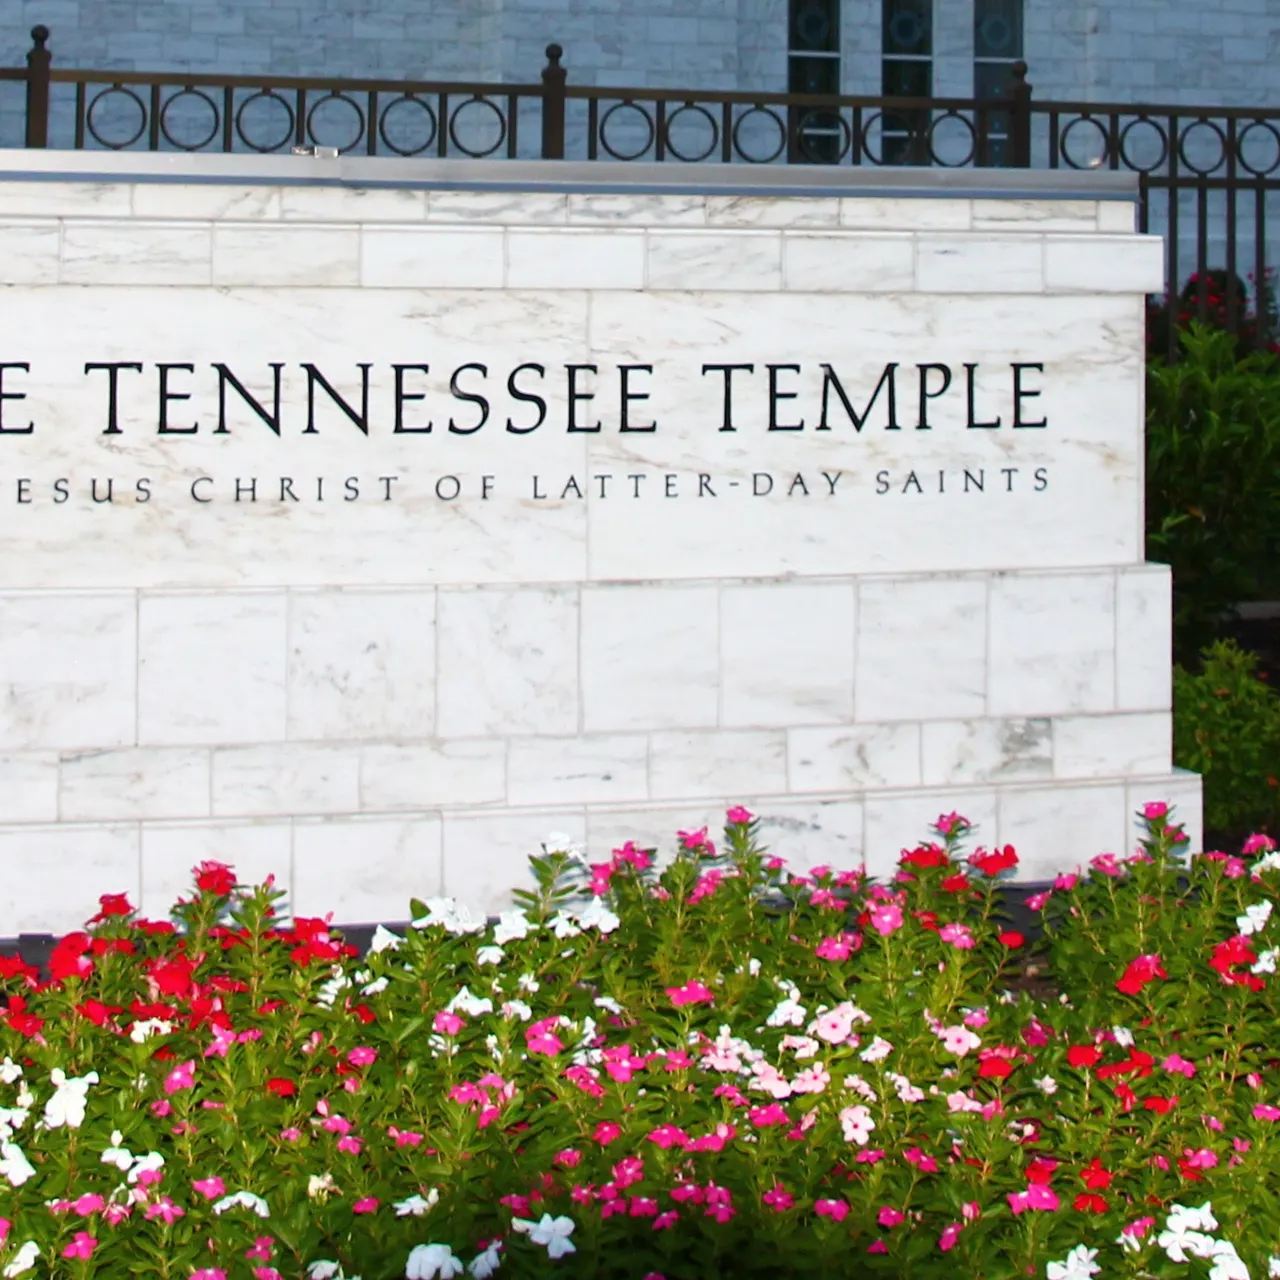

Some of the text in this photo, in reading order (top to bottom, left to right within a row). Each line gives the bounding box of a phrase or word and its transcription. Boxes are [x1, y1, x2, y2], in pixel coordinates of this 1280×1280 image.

[84, 362, 658, 437] TENNESSEE
[701, 361, 1049, 433] TEMPLE
[190, 476, 399, 504] CHRIST
[434, 475, 496, 501] OF
[532, 471, 844, 500] LATTER-DAY
[875, 467, 1049, 495] SAINTS
